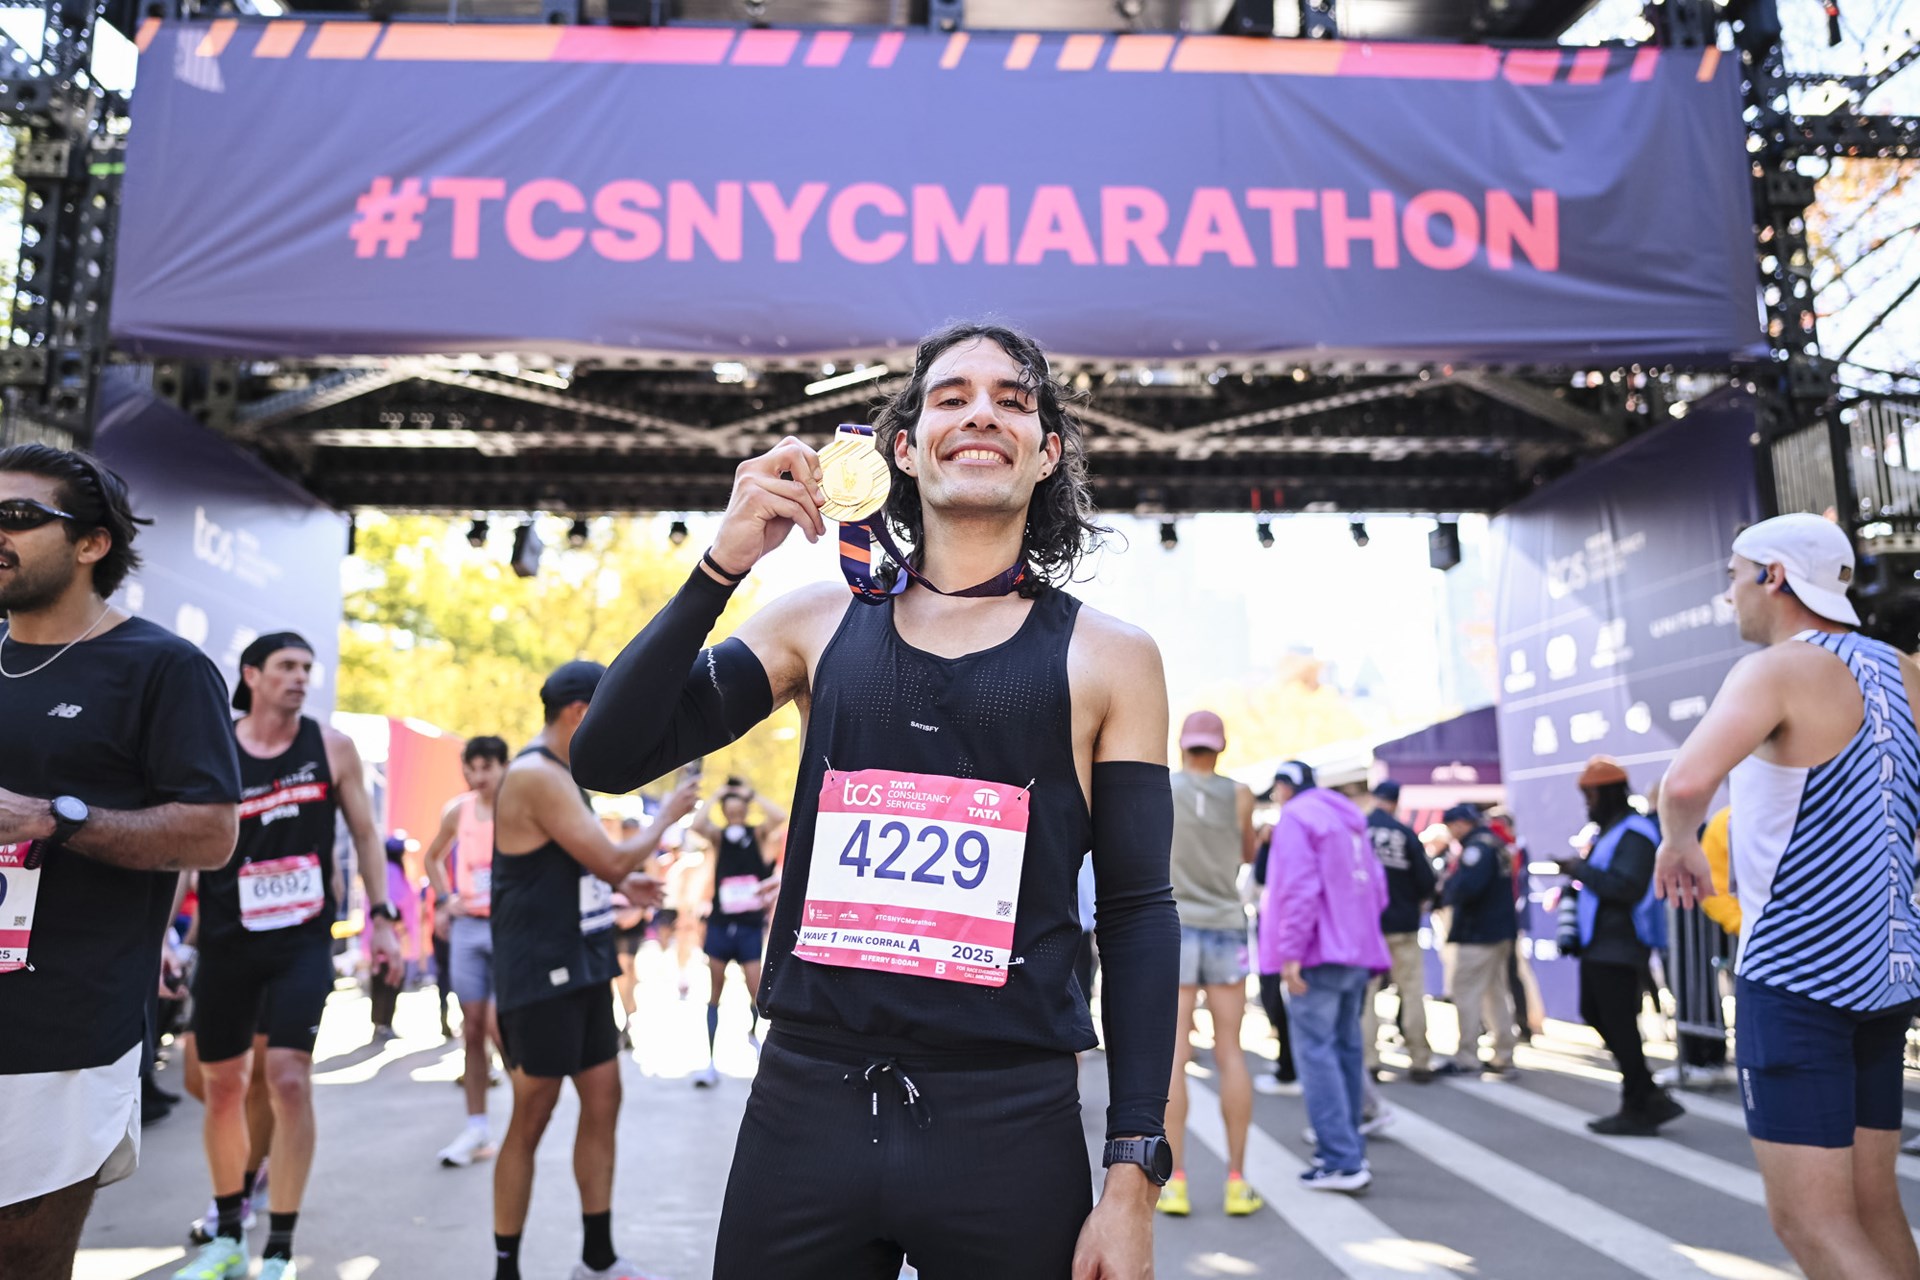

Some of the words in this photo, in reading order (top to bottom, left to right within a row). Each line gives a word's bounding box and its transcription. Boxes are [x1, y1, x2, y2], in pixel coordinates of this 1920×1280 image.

[349, 176, 1559, 272] #TCSNYCMARATHON
[910, 720, 940, 732] SATISFY
[889, 780, 916, 790] TATA
[843, 778, 884, 807] tcs
[887, 790, 952, 804] CONSULTANCY
[886, 800, 927, 811] SERVICES
[967, 806, 1002, 821] TATA
[838, 819, 990, 890] 4229
[253, 869, 311, 899] 6692
[875, 914, 937, 927] #TCSNYCMarathon
[803, 931, 828, 941] WAVE
[830, 931, 838, 944] 1
[842, 934, 864, 944] PINK
[865, 936, 906, 949] CORRAL
[908, 938, 920, 953] A
[868, 955, 890, 964] FERRY
[952, 944, 994, 964] 2025
[935, 961, 946, 975] B
